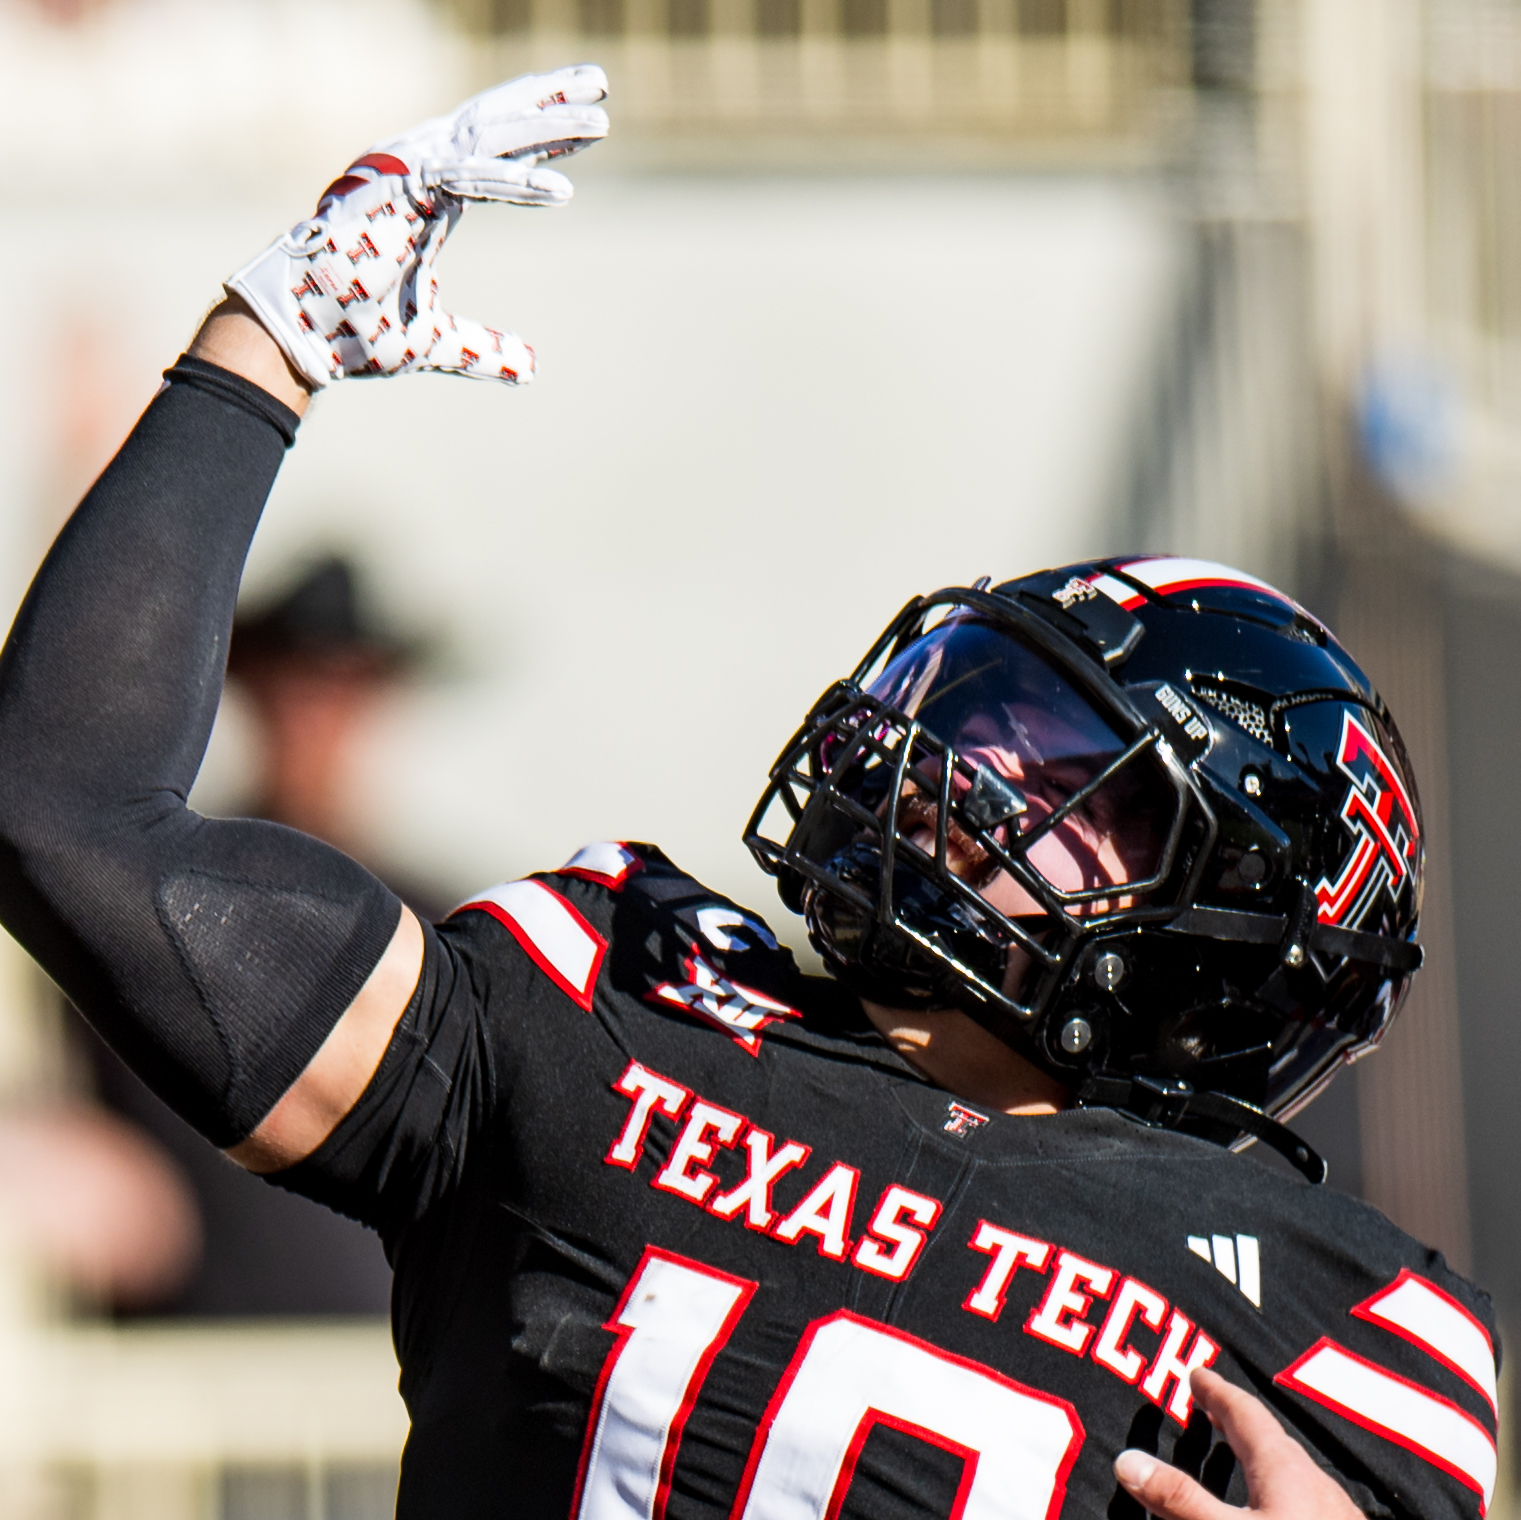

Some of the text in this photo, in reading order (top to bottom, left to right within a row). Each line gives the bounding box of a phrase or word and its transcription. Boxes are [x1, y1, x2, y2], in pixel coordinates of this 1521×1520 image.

[1155, 683, 1208, 740] GUNS UP
[605, 1058, 1221, 1429] TEXAS TECH
